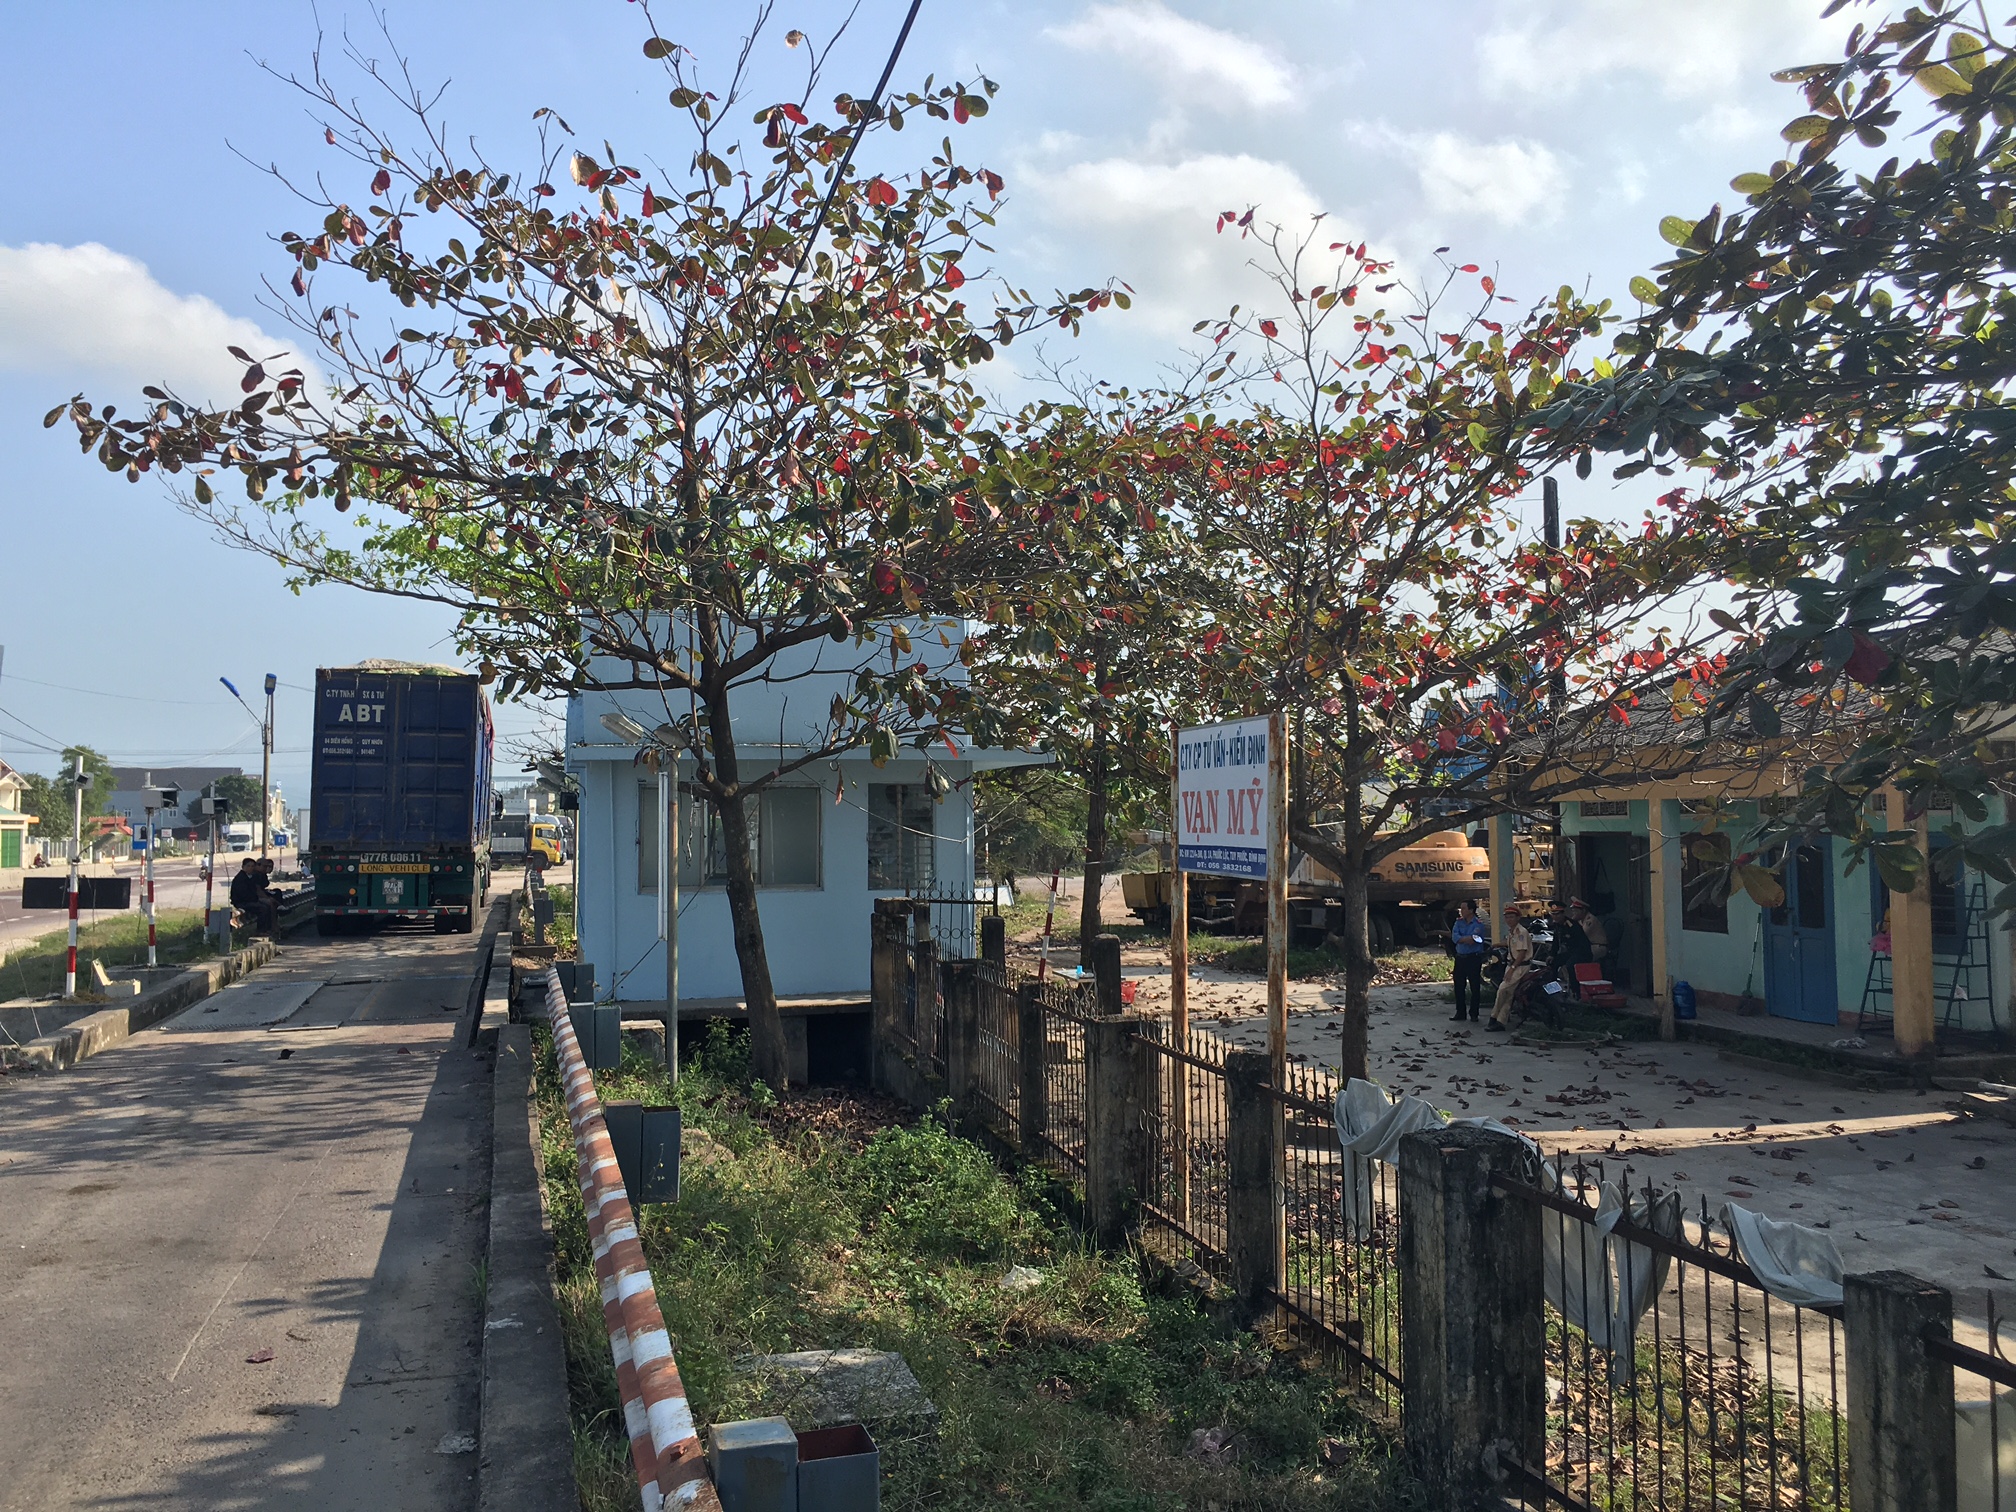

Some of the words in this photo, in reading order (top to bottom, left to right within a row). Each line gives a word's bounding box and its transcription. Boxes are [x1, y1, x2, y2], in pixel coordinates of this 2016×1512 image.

[338, 704, 385, 723] ABT
[1193, 742, 1201, 770] CP
[1182, 790, 1219, 842] VẠN
[1227, 777, 1264, 835] MỸ
[390, 864, 428, 872] VEHICLE
[1395, 862, 1464, 872] SAMSUNG
